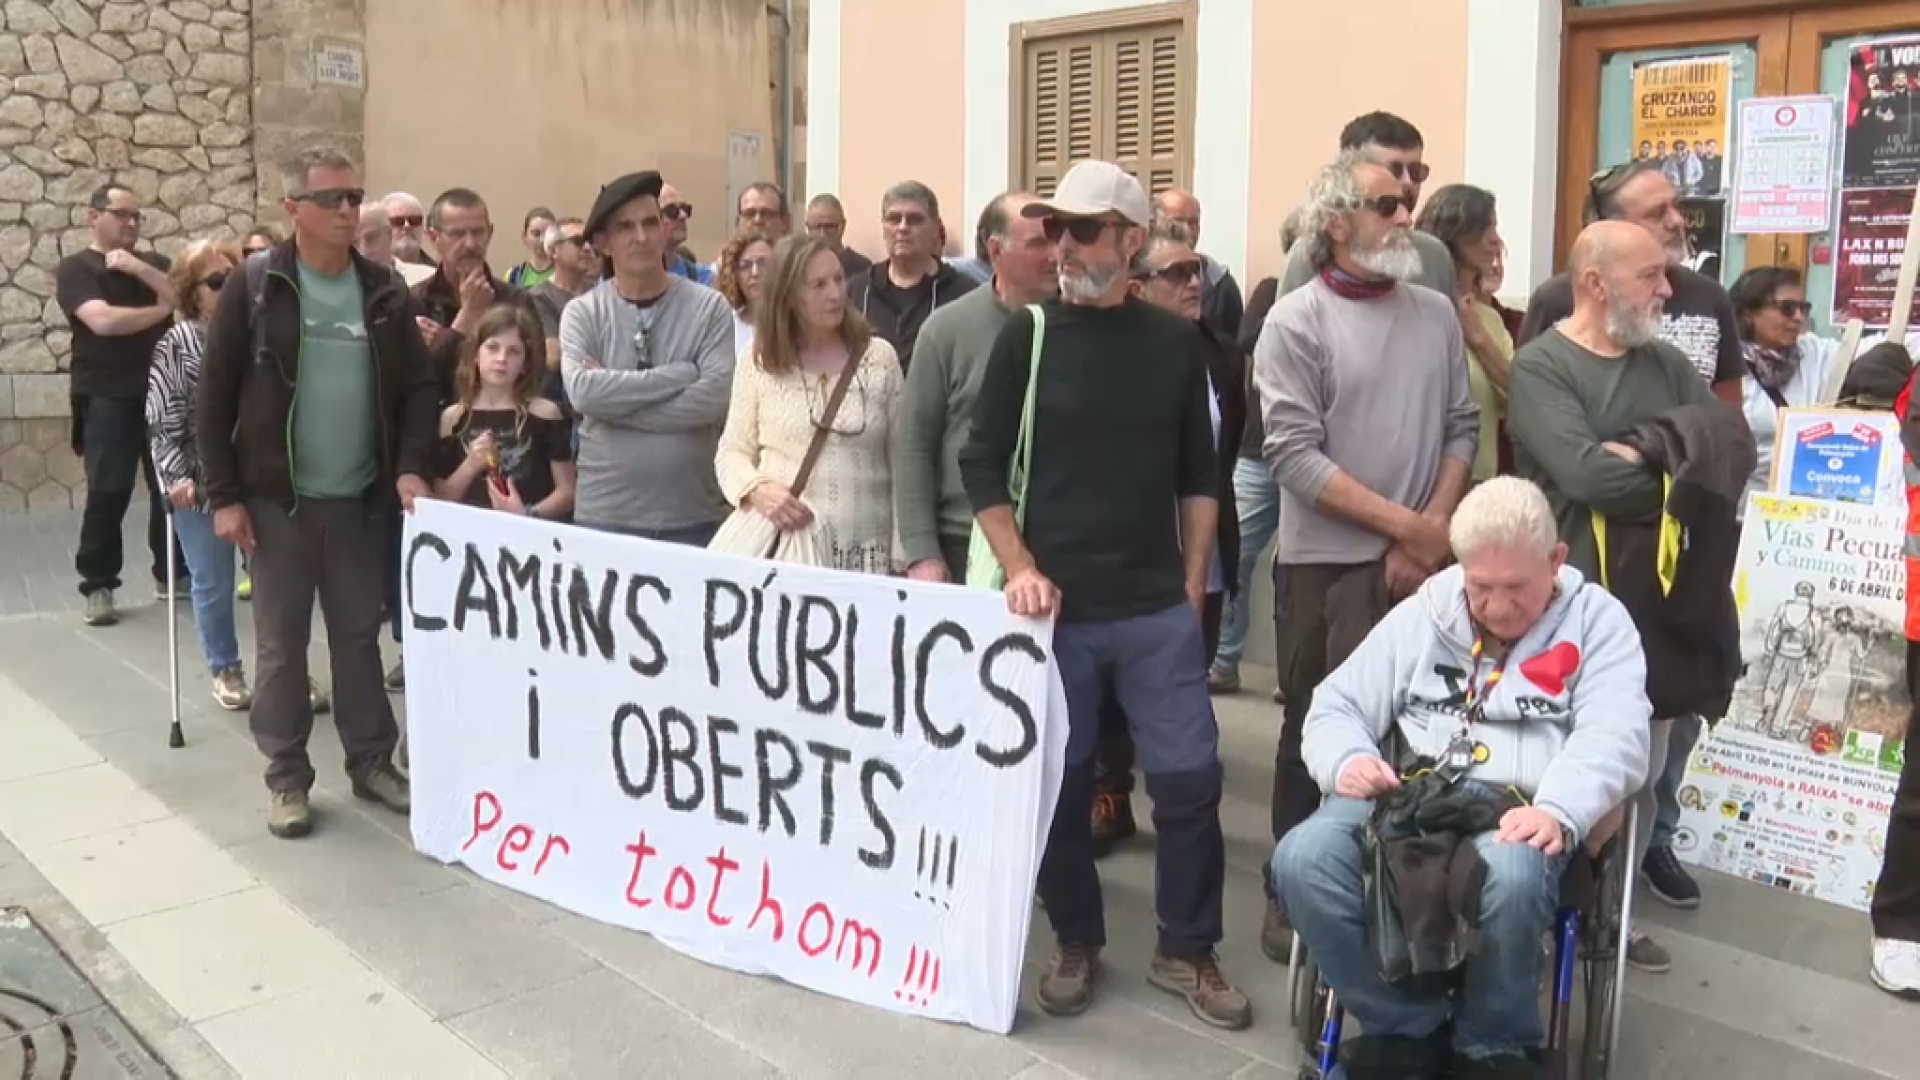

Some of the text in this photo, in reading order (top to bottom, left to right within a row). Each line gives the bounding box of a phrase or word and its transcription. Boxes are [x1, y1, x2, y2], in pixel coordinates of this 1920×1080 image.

[1642, 90, 1717, 106] CRUZANDO
[1642, 105, 1717, 118] EL CHARCO
[1806, 470, 1861, 485] Convoca
[1763, 519, 1816, 549] Vías
[1773, 547, 1857, 576] Caminos
[1829, 576, 1838, 591] 6
[1840, 578, 1856, 594] DE
[1857, 581, 1892, 600] ABRIL
[610, 702, 904, 869] OBERTS
[1711, 760, 1786, 790] Palmanyola
[1798, 781, 1838, 801] RAIXA
[1842, 775, 1897, 795] BUNYOLA
[625, 831, 884, 978] tothom
